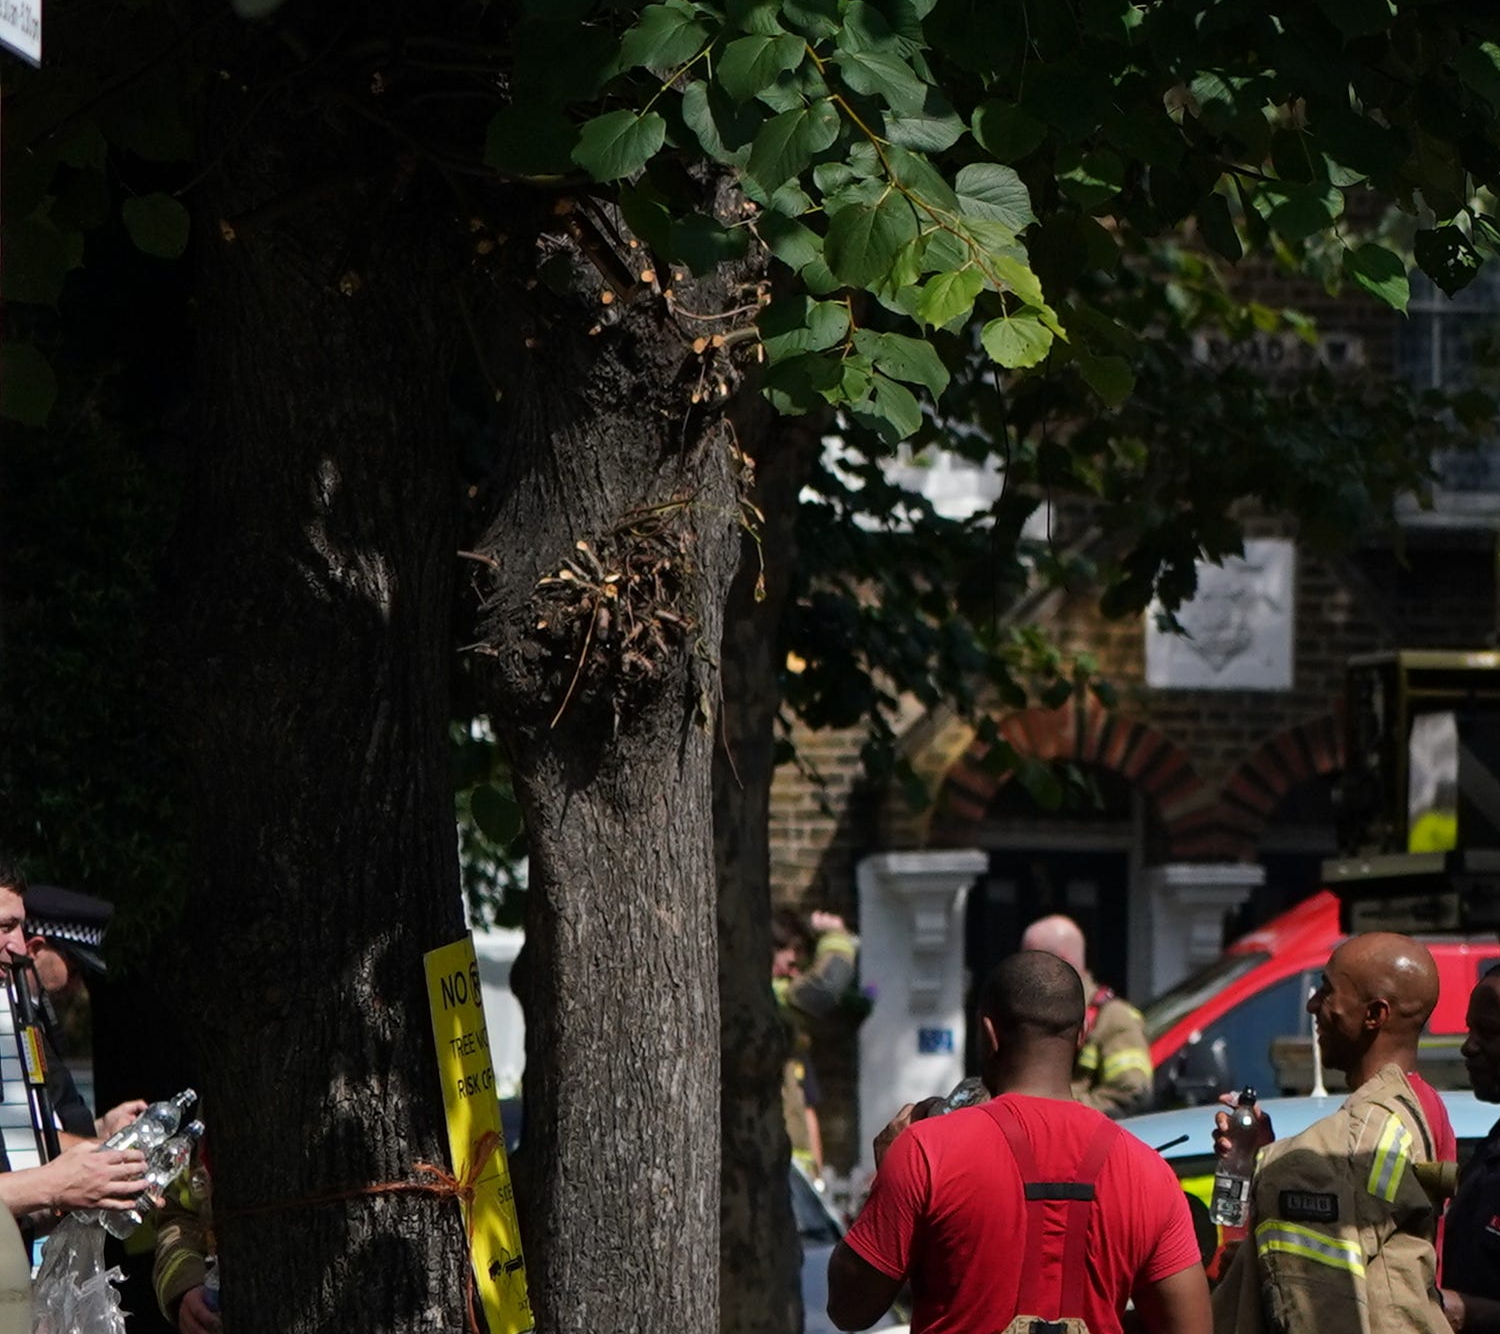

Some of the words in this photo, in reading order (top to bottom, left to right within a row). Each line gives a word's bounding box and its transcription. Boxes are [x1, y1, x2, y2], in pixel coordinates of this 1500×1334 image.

[441, 971, 467, 1010] NO
[450, 1033, 475, 1059] TREE
[457, 1075, 480, 1100] RISK
